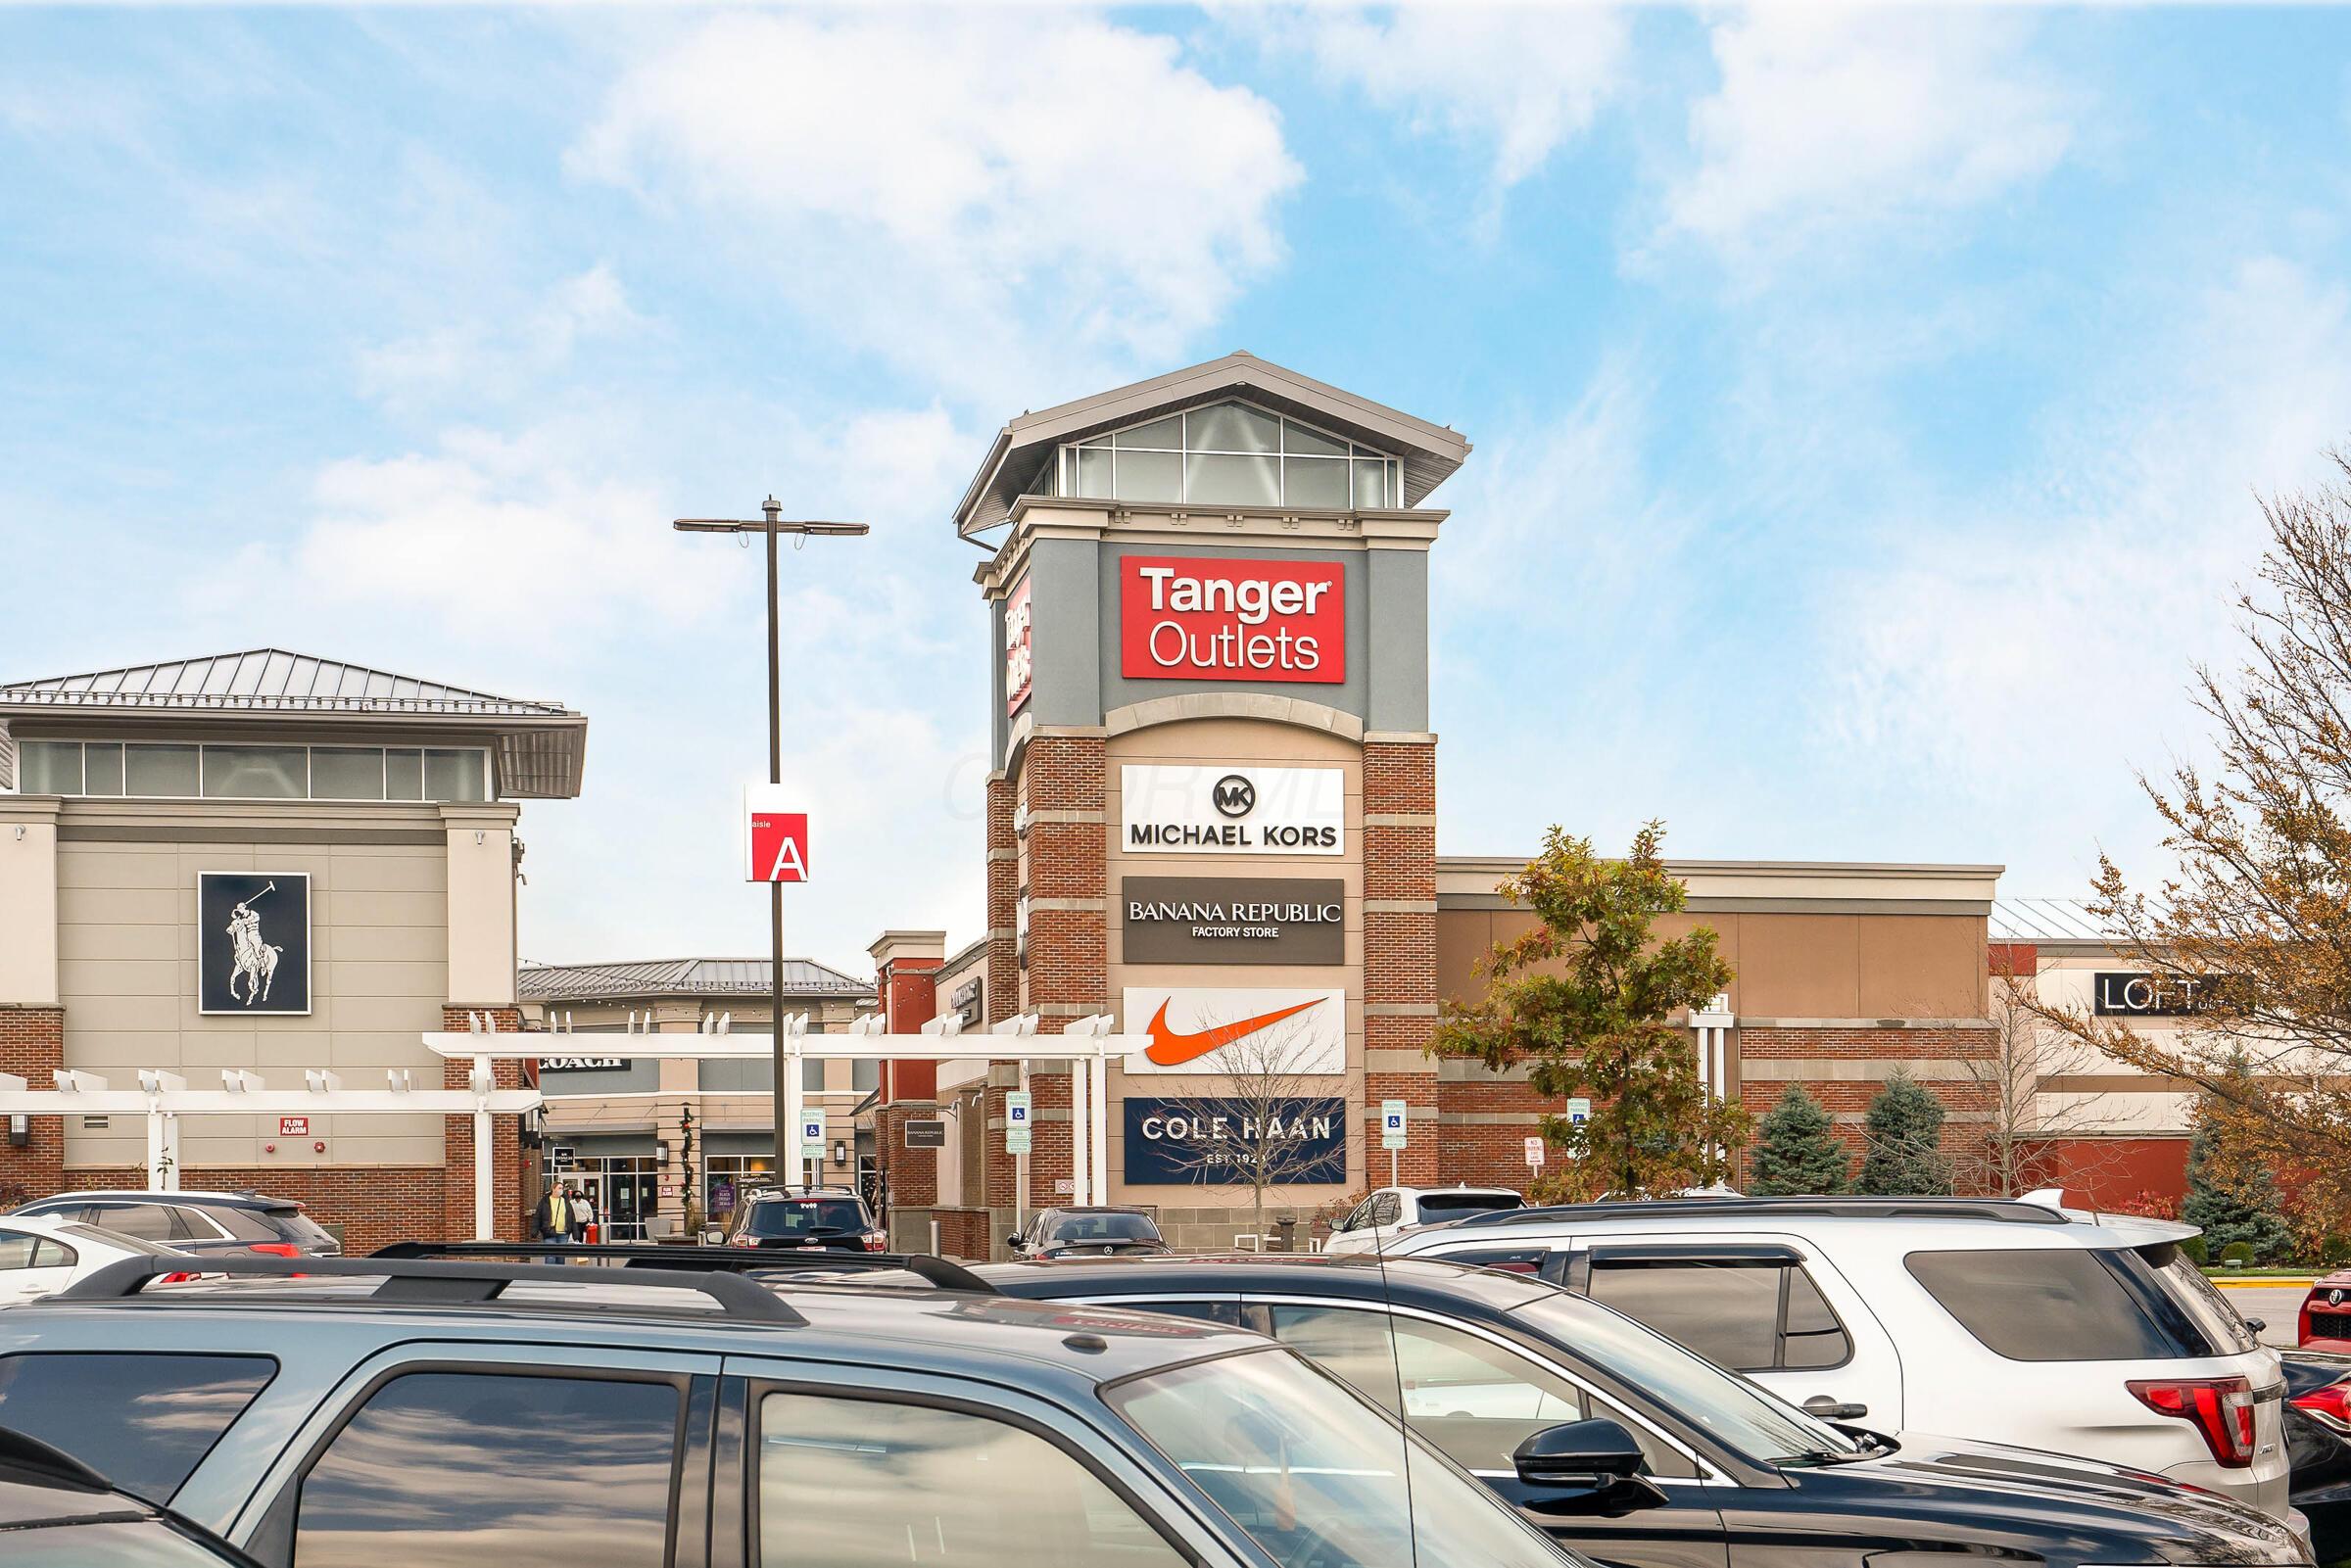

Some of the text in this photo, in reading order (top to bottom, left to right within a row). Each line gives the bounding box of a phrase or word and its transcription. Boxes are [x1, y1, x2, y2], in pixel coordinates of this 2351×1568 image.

[1138, 566, 1328, 625] Tanger
[1148, 620, 1320, 671] Outlets
[752, 820, 771, 829] aisle
[1130, 824, 1337, 848] MICHAEL KORS
[768, 836, 808, 880] A
[1128, 901, 1341, 924] BANANA REPUBLIC
[1192, 927, 1279, 938] FACTORY STORE
[2104, 978, 2201, 1010] LOFT
[282, 1126, 307, 1135] ALARM
[1142, 1117, 1330, 1140] COLE HAAN
